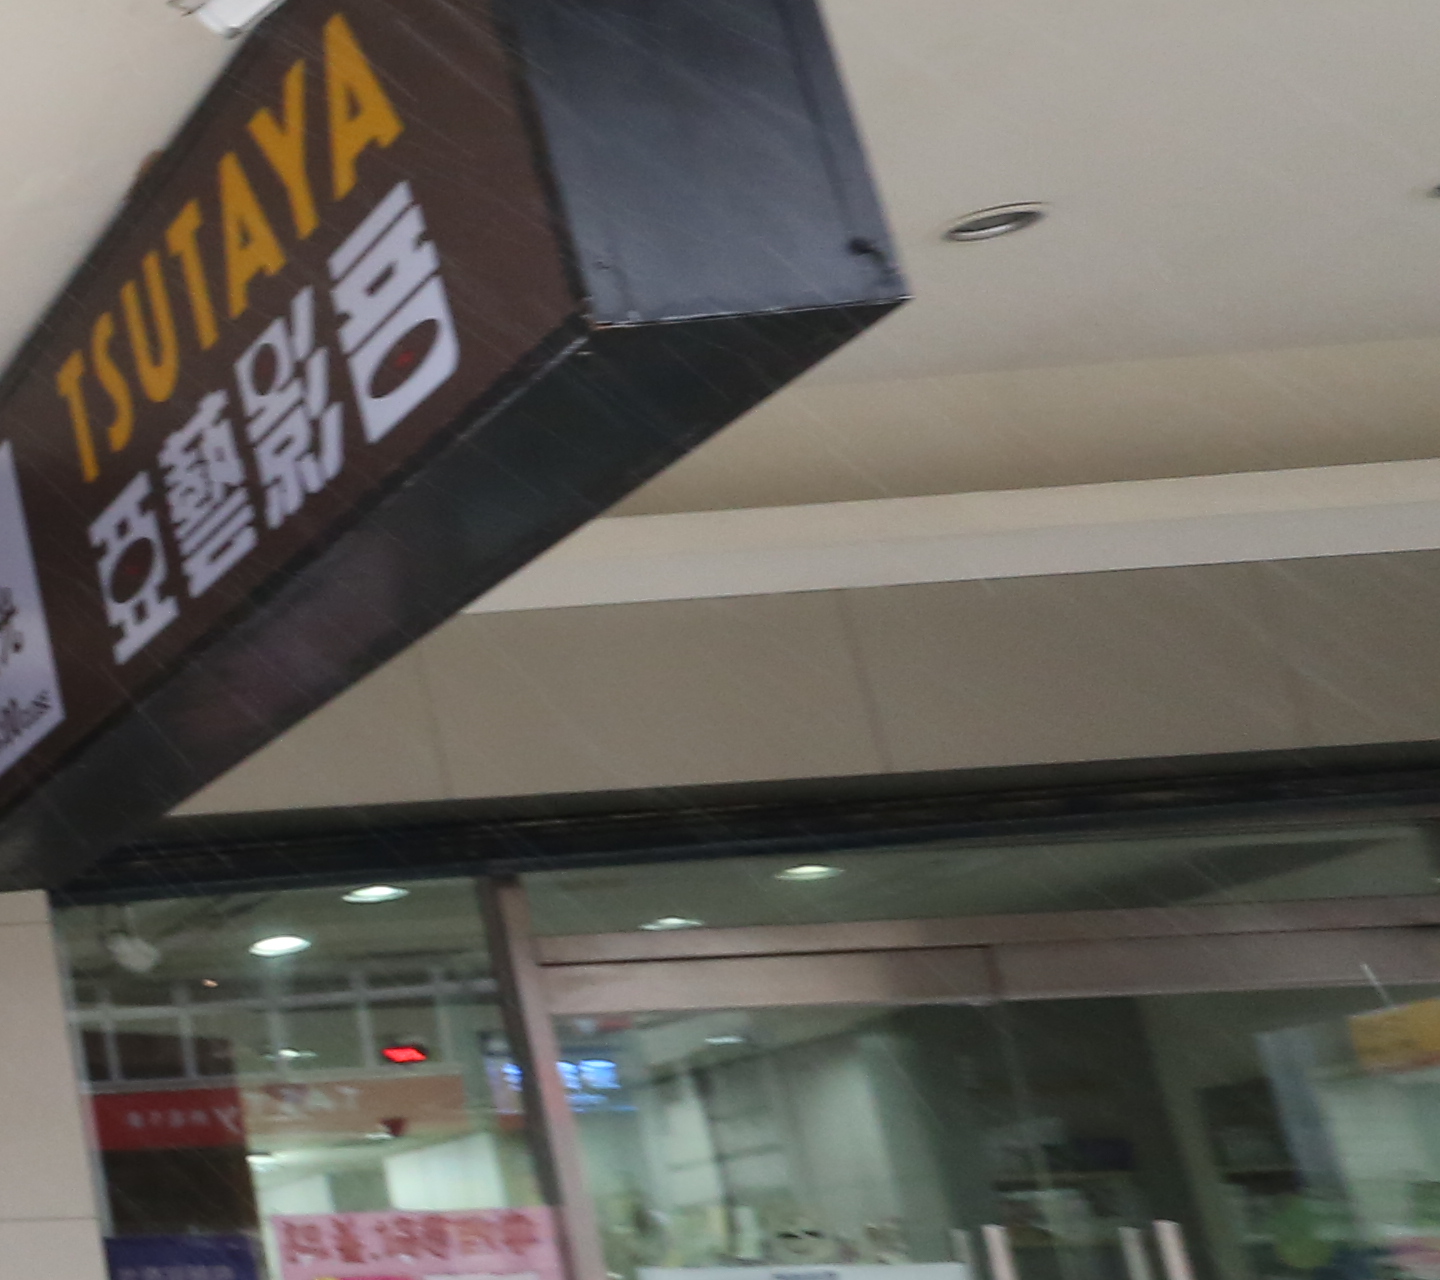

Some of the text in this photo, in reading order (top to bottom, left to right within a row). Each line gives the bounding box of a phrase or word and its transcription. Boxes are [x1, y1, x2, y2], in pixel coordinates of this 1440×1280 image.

[56, 13, 404, 481] TSUTAYA
[89, 180, 461, 665] 亞藝影音
